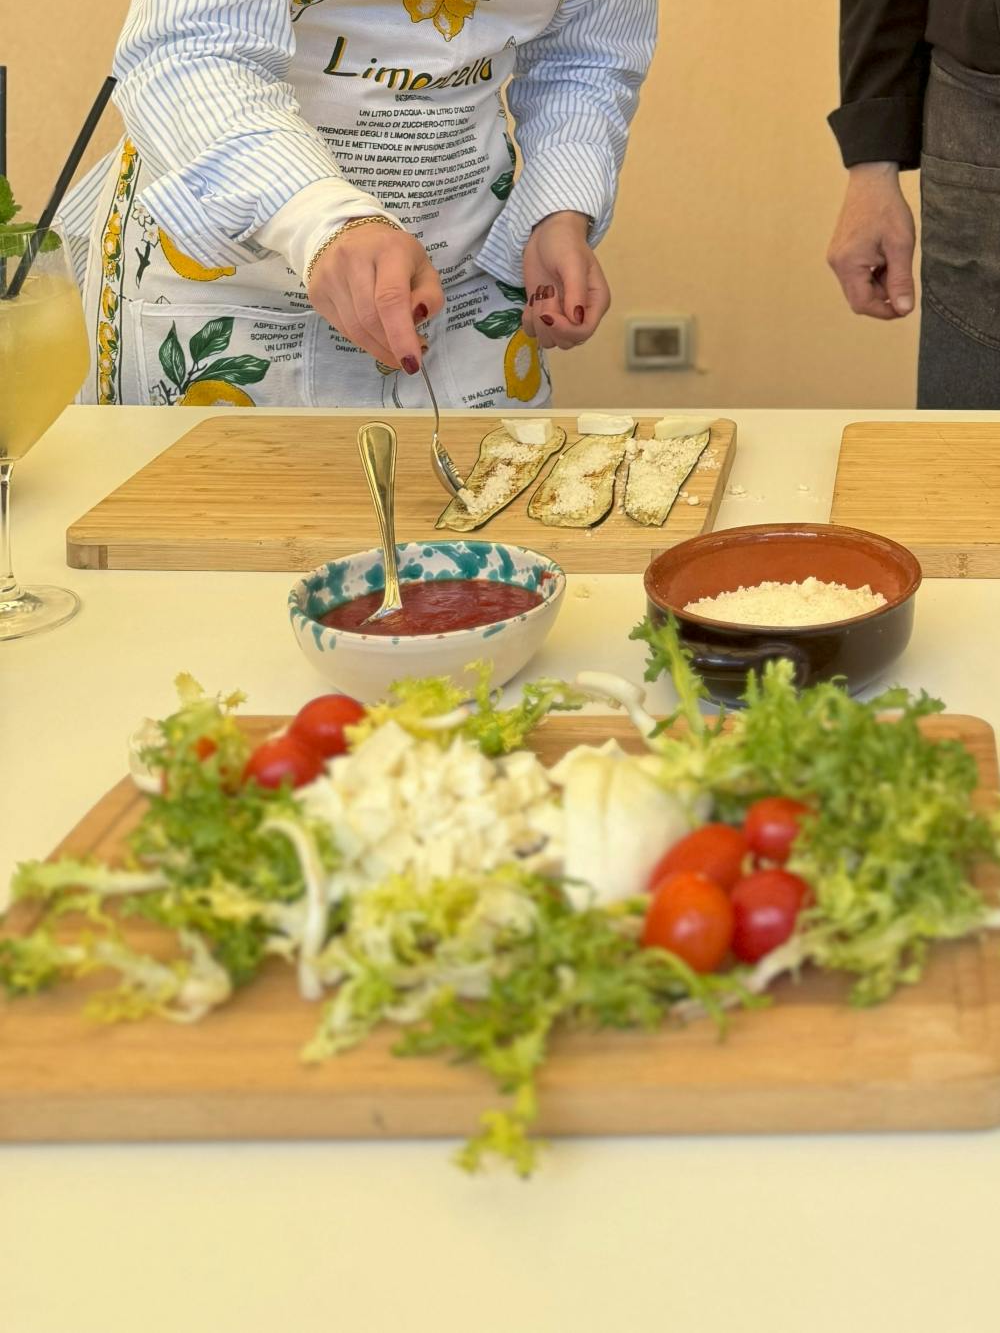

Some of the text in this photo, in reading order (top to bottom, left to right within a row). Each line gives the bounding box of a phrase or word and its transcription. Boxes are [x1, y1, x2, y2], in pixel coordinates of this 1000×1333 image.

[371, 110, 392, 118] LITRO
[393, 108, 422, 117] D'ACQUA
[426, 108, 436, 116] UN
[317, 126, 359, 137] PRENDERE
[360, 129, 382, 138] DEGLI
[351, 141, 403, 151] METTENDOLE
[354, 153, 362, 161] IN
[364, 154, 375, 162] UN
[376, 155, 419, 164] BARATTOLO
[375, 168, 401, 176] GIORNI
[253, 322, 297, 331] ASPETTATE
